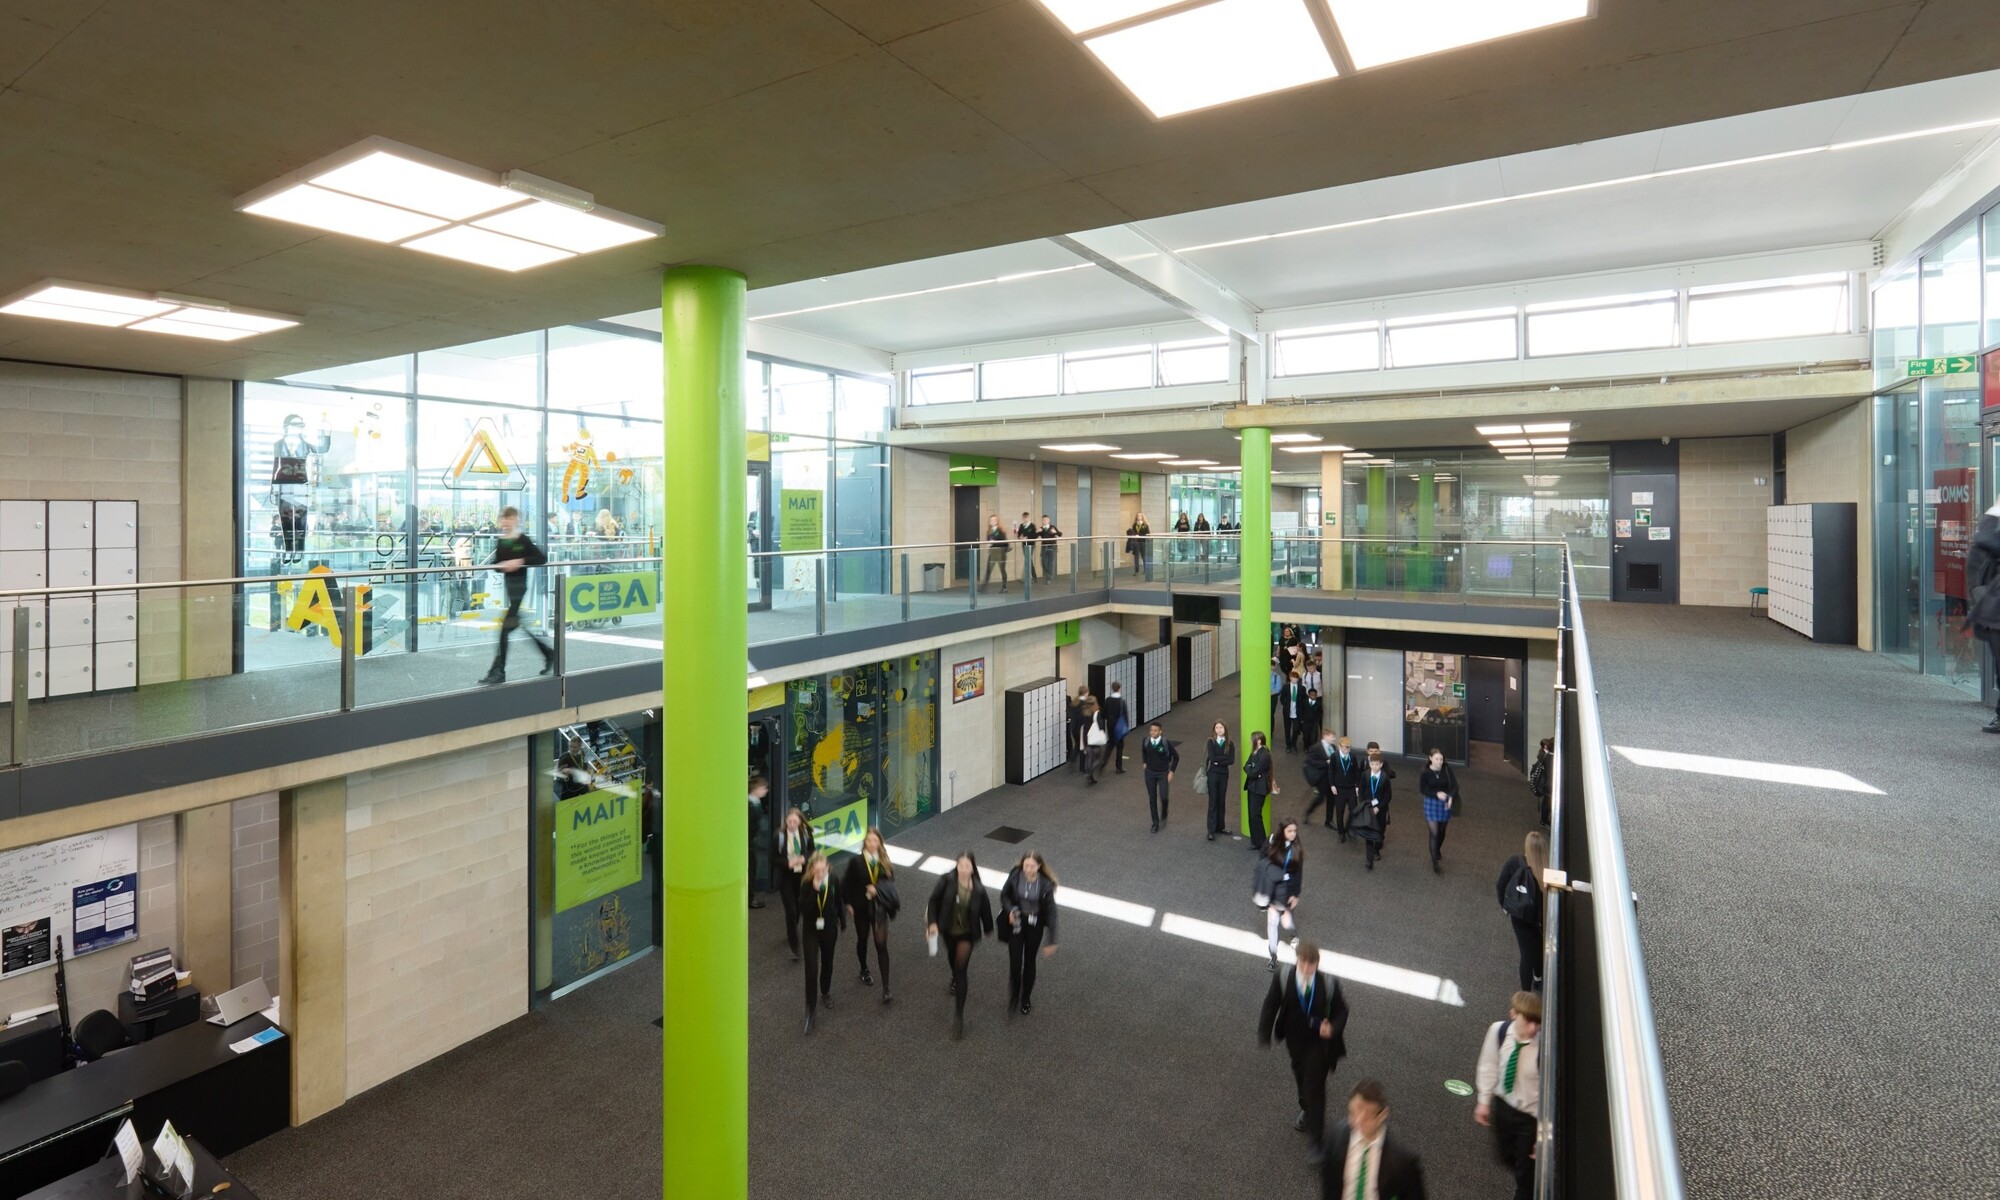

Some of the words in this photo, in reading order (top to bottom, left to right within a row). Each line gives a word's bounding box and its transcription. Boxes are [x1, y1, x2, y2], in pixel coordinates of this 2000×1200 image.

[788, 497, 816, 510] MAIT
[570, 578, 649, 614] CBA
[573, 796, 628, 831] MAIT
